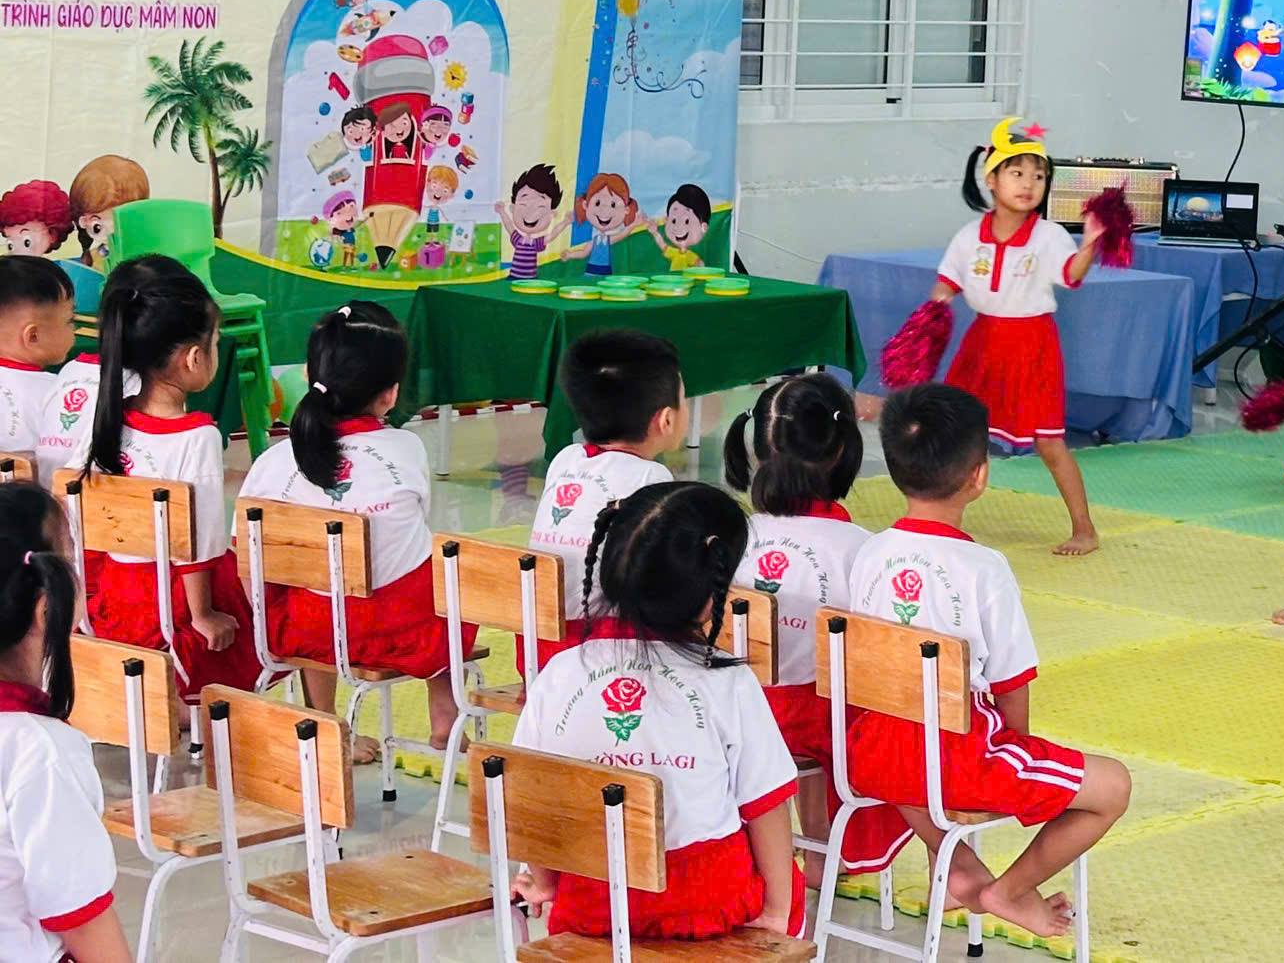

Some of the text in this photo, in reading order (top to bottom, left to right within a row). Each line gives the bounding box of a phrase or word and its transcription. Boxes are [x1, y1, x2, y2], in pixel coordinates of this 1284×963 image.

[1, 0, 51, 27] TRÌNH
[57, 0, 94, 28] GIÁO
[100, 5, 134, 33] DỤC
[183, 6, 217, 30] NON
[778, 616, 808, 631] AGI
[651, 752, 695, 769] LAGI
